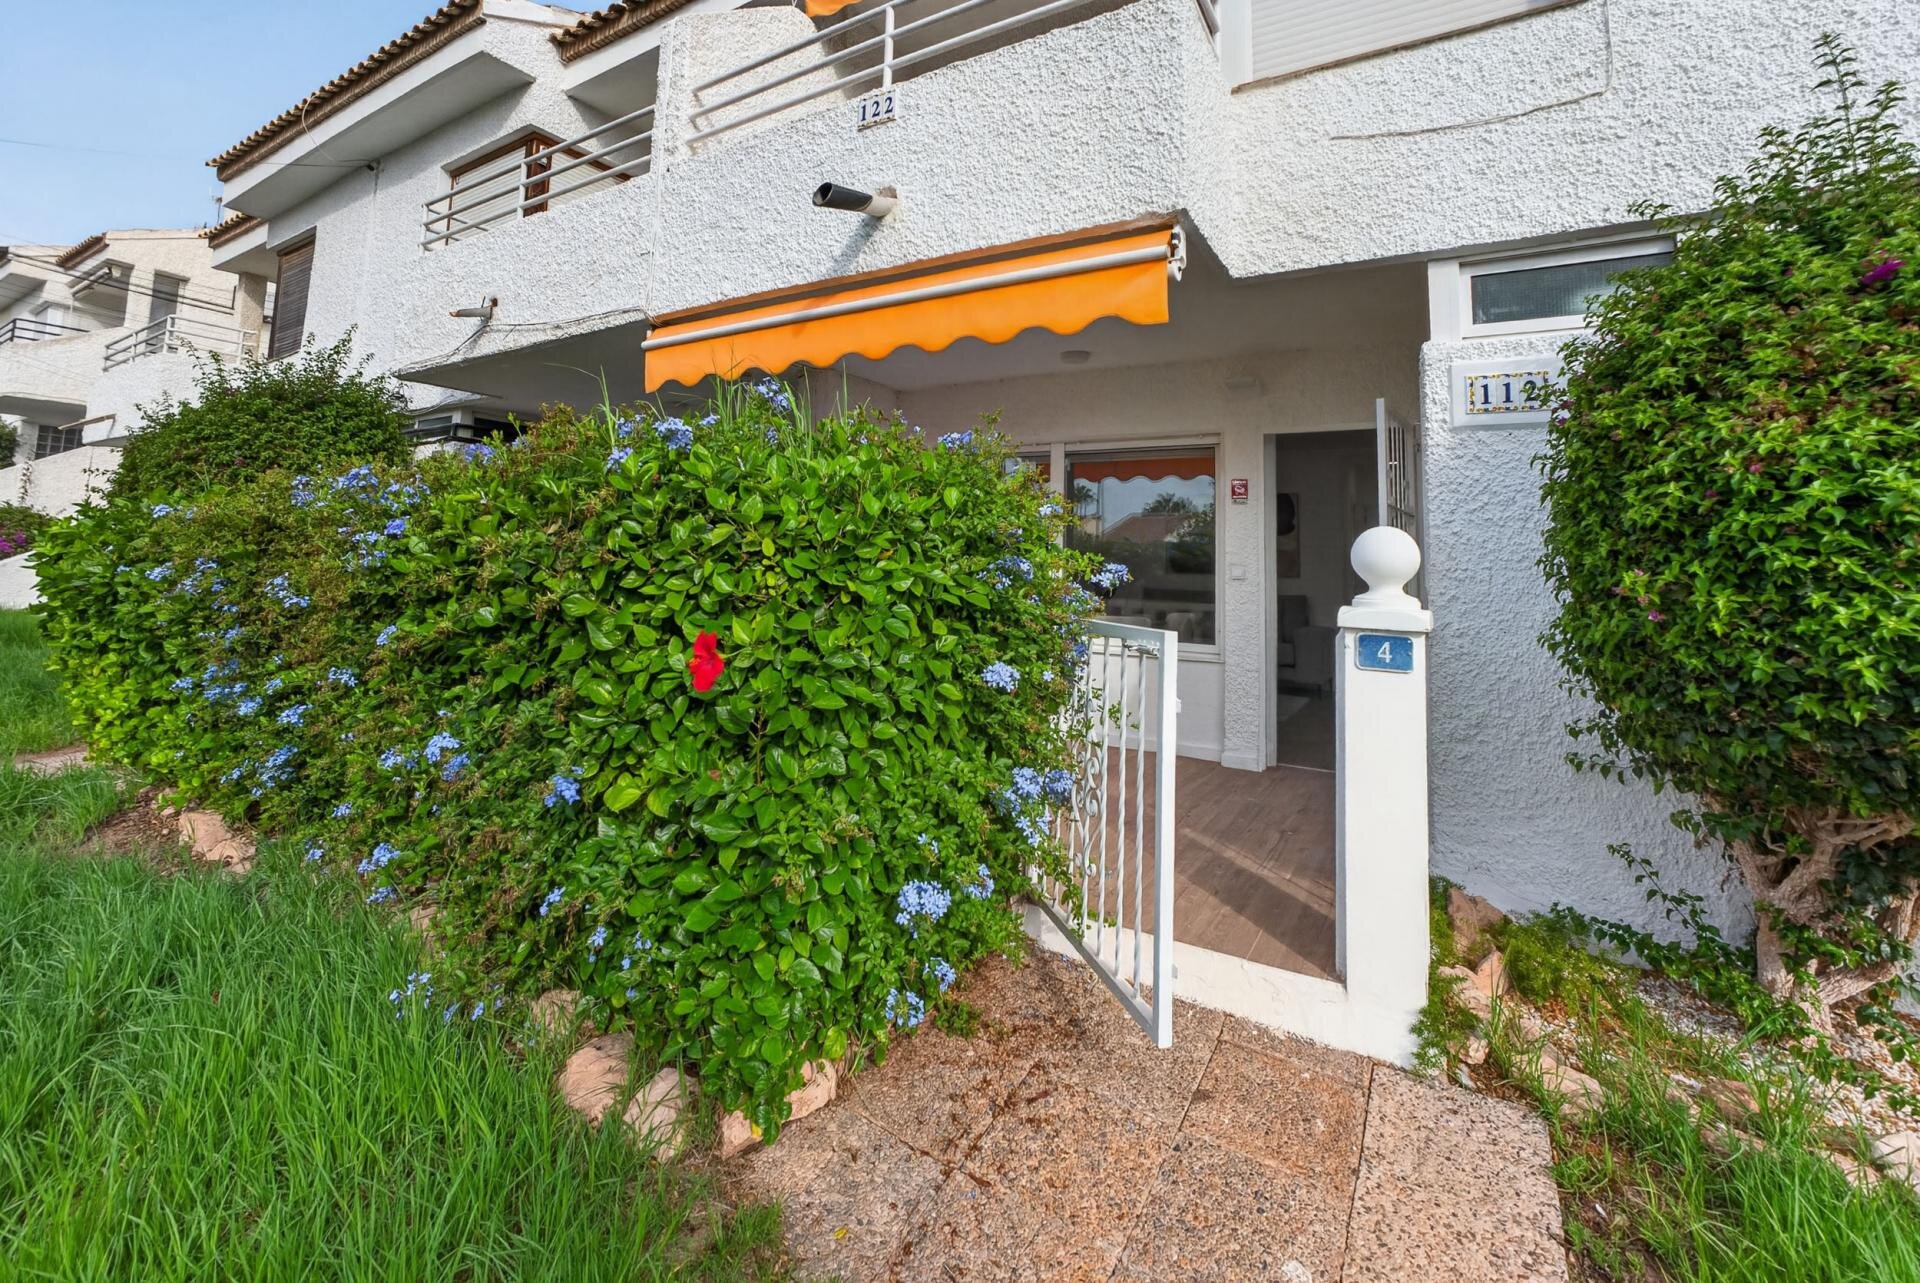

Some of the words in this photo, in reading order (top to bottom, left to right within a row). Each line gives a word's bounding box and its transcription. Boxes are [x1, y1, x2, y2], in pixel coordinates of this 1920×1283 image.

[861, 96, 893, 121] 122
[1481, 380, 1538, 405] 112
[1378, 641, 1393, 664] 4
